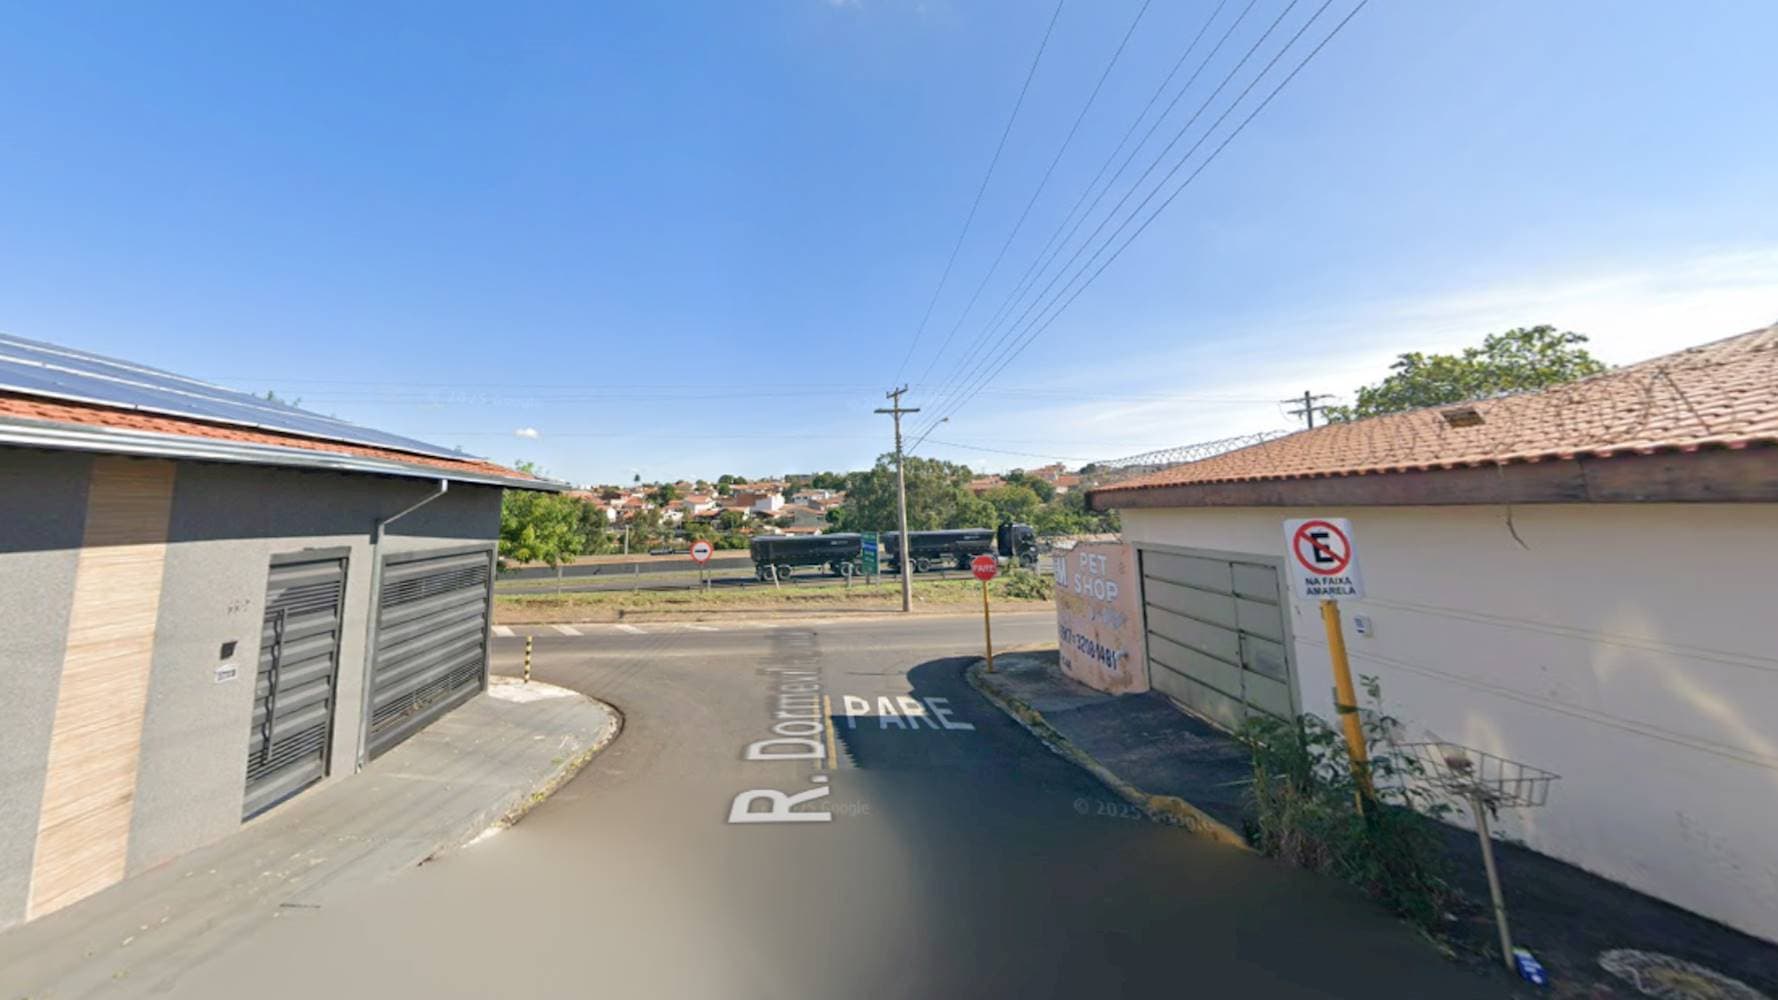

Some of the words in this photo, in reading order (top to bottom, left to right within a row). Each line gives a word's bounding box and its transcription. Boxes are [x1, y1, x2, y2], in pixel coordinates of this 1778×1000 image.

[1310, 533, 1335, 563] E
[972, 563, 999, 573] PARE
[1079, 552, 1107, 577] PET
[1073, 573, 1119, 602] SHOP
[1305, 577, 1321, 585] NA
[1322, 577, 1353, 585] FAIXA
[1306, 586, 1357, 596] AMARELA
[842, 694, 976, 731] PARE
